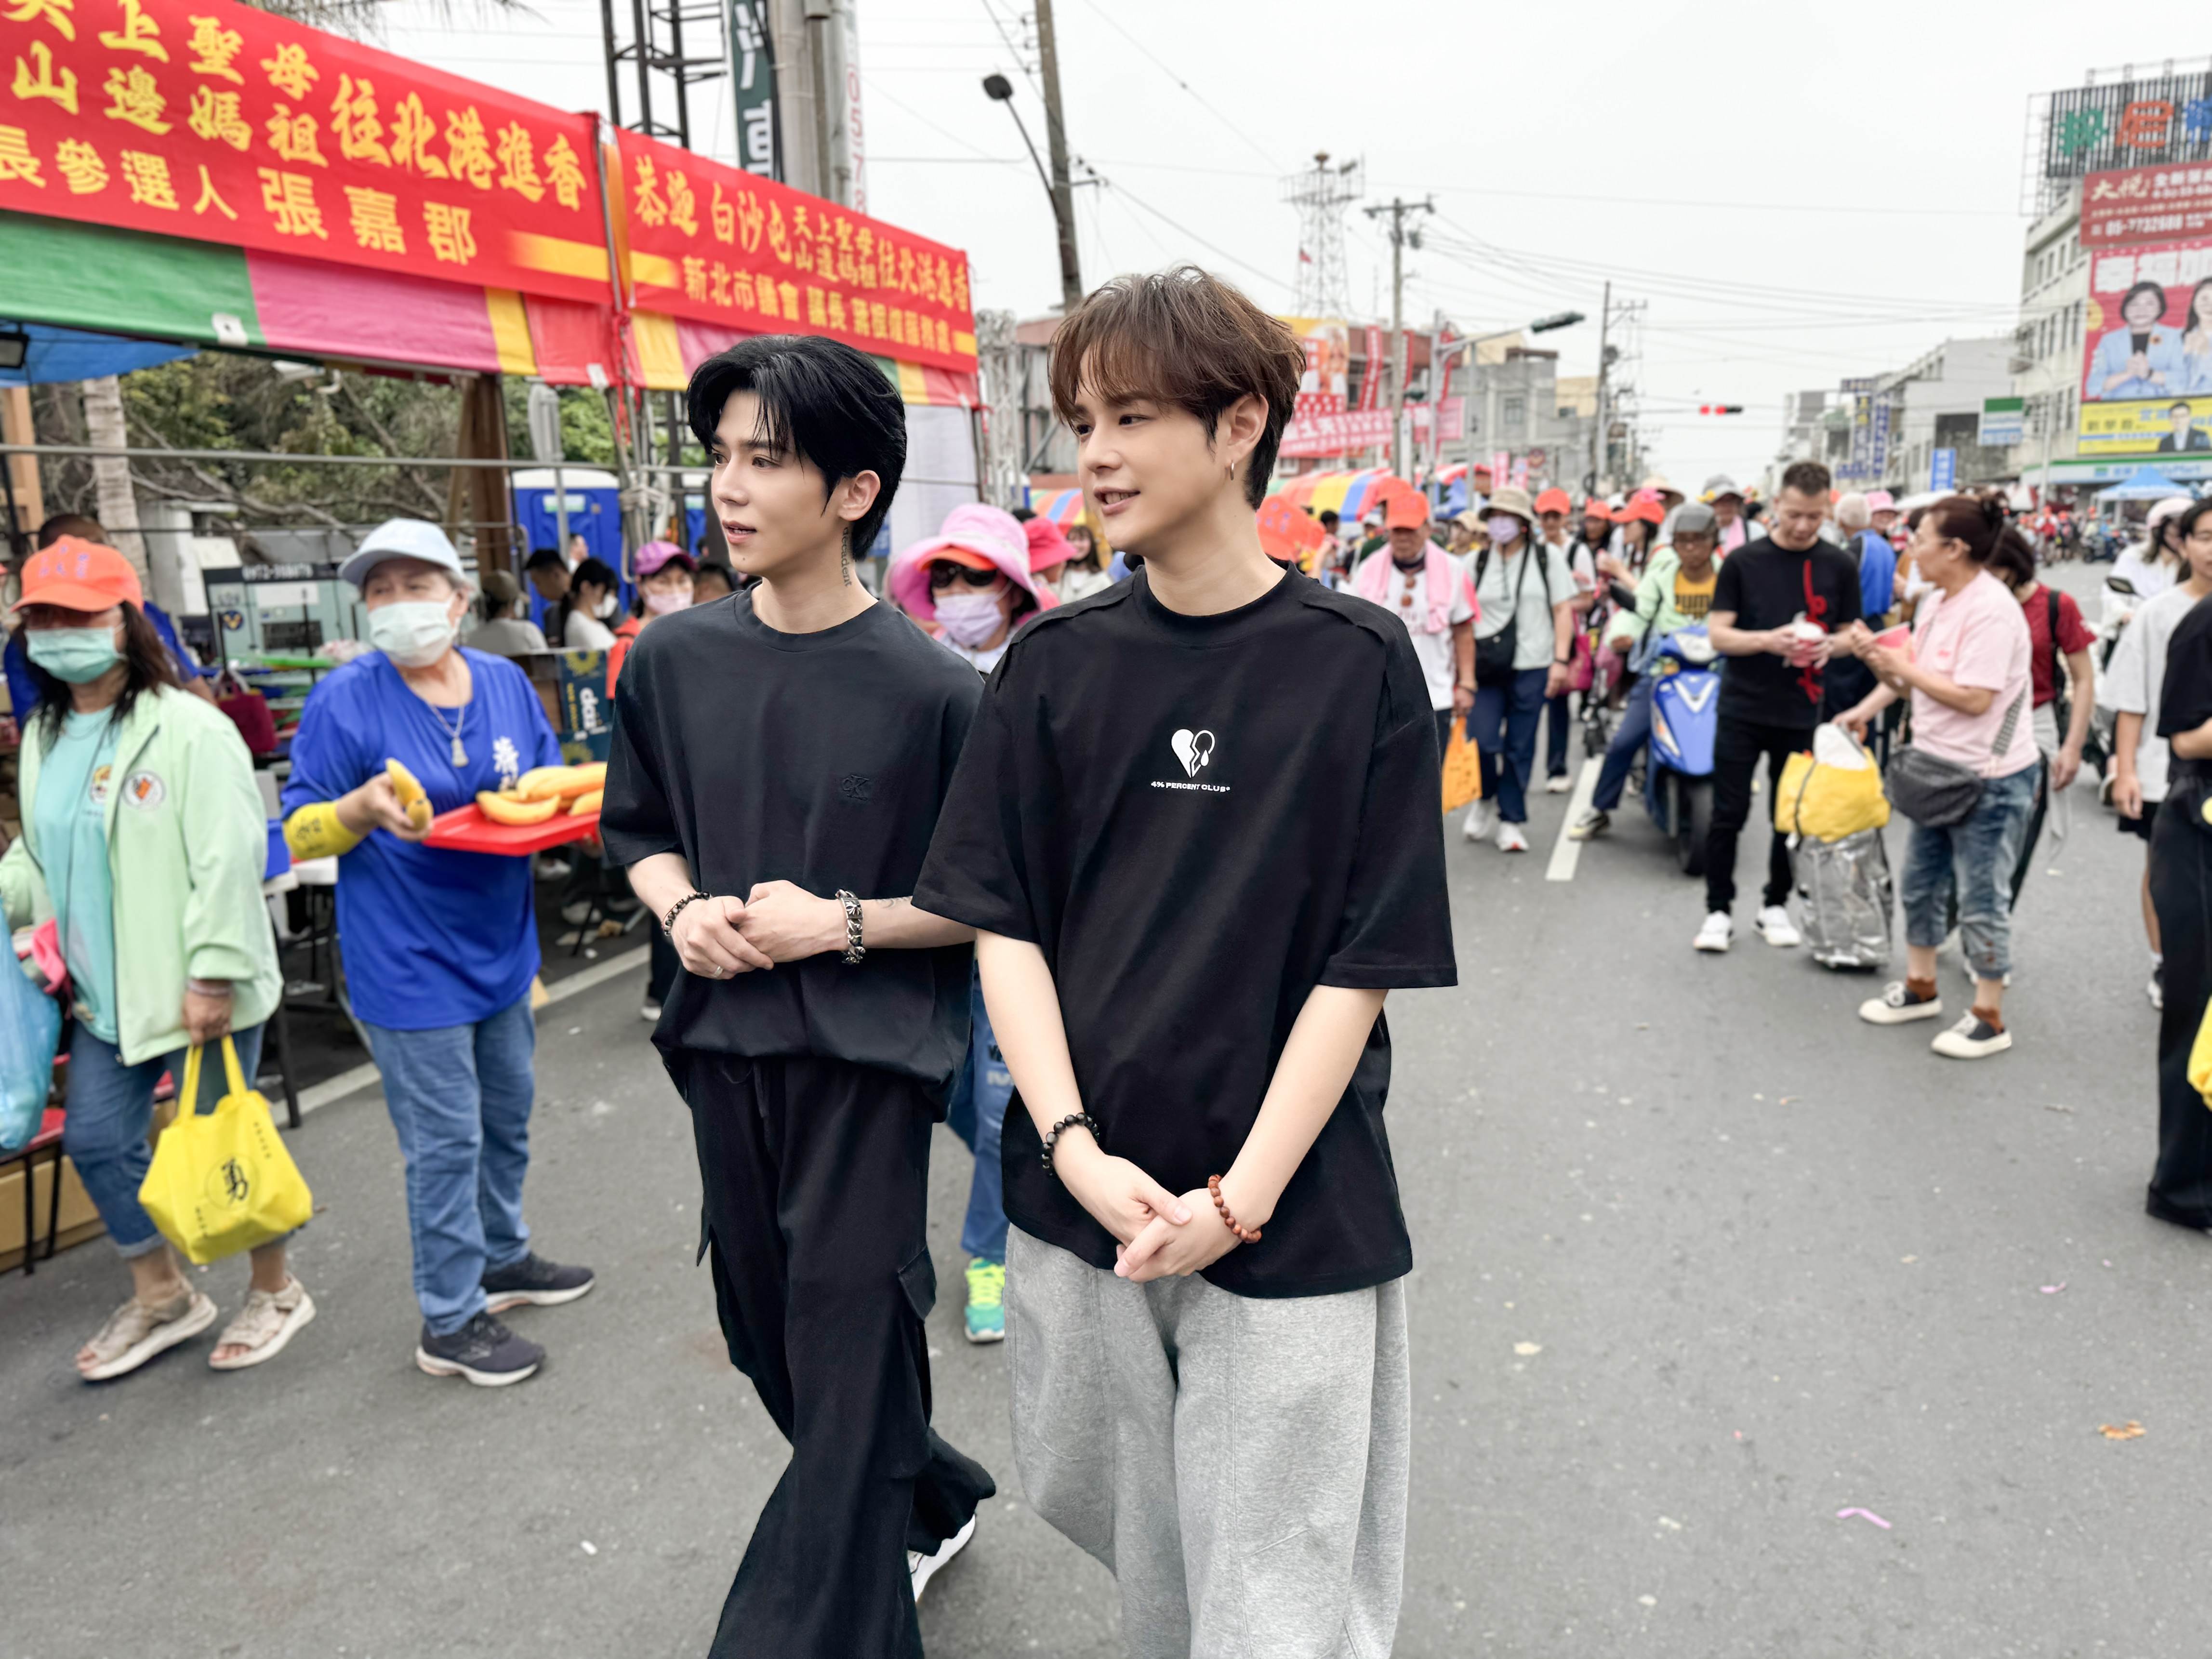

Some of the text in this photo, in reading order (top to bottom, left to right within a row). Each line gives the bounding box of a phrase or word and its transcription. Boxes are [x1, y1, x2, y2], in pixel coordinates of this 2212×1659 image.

[11, 40, 329, 168] 山邊媽祖
[330, 72, 587, 212] 往北港進香
[257, 167, 477, 265] 張嘉郡
[841, 527, 852, 587] decadent
[1166, 782, 1200, 790] PERCENT
